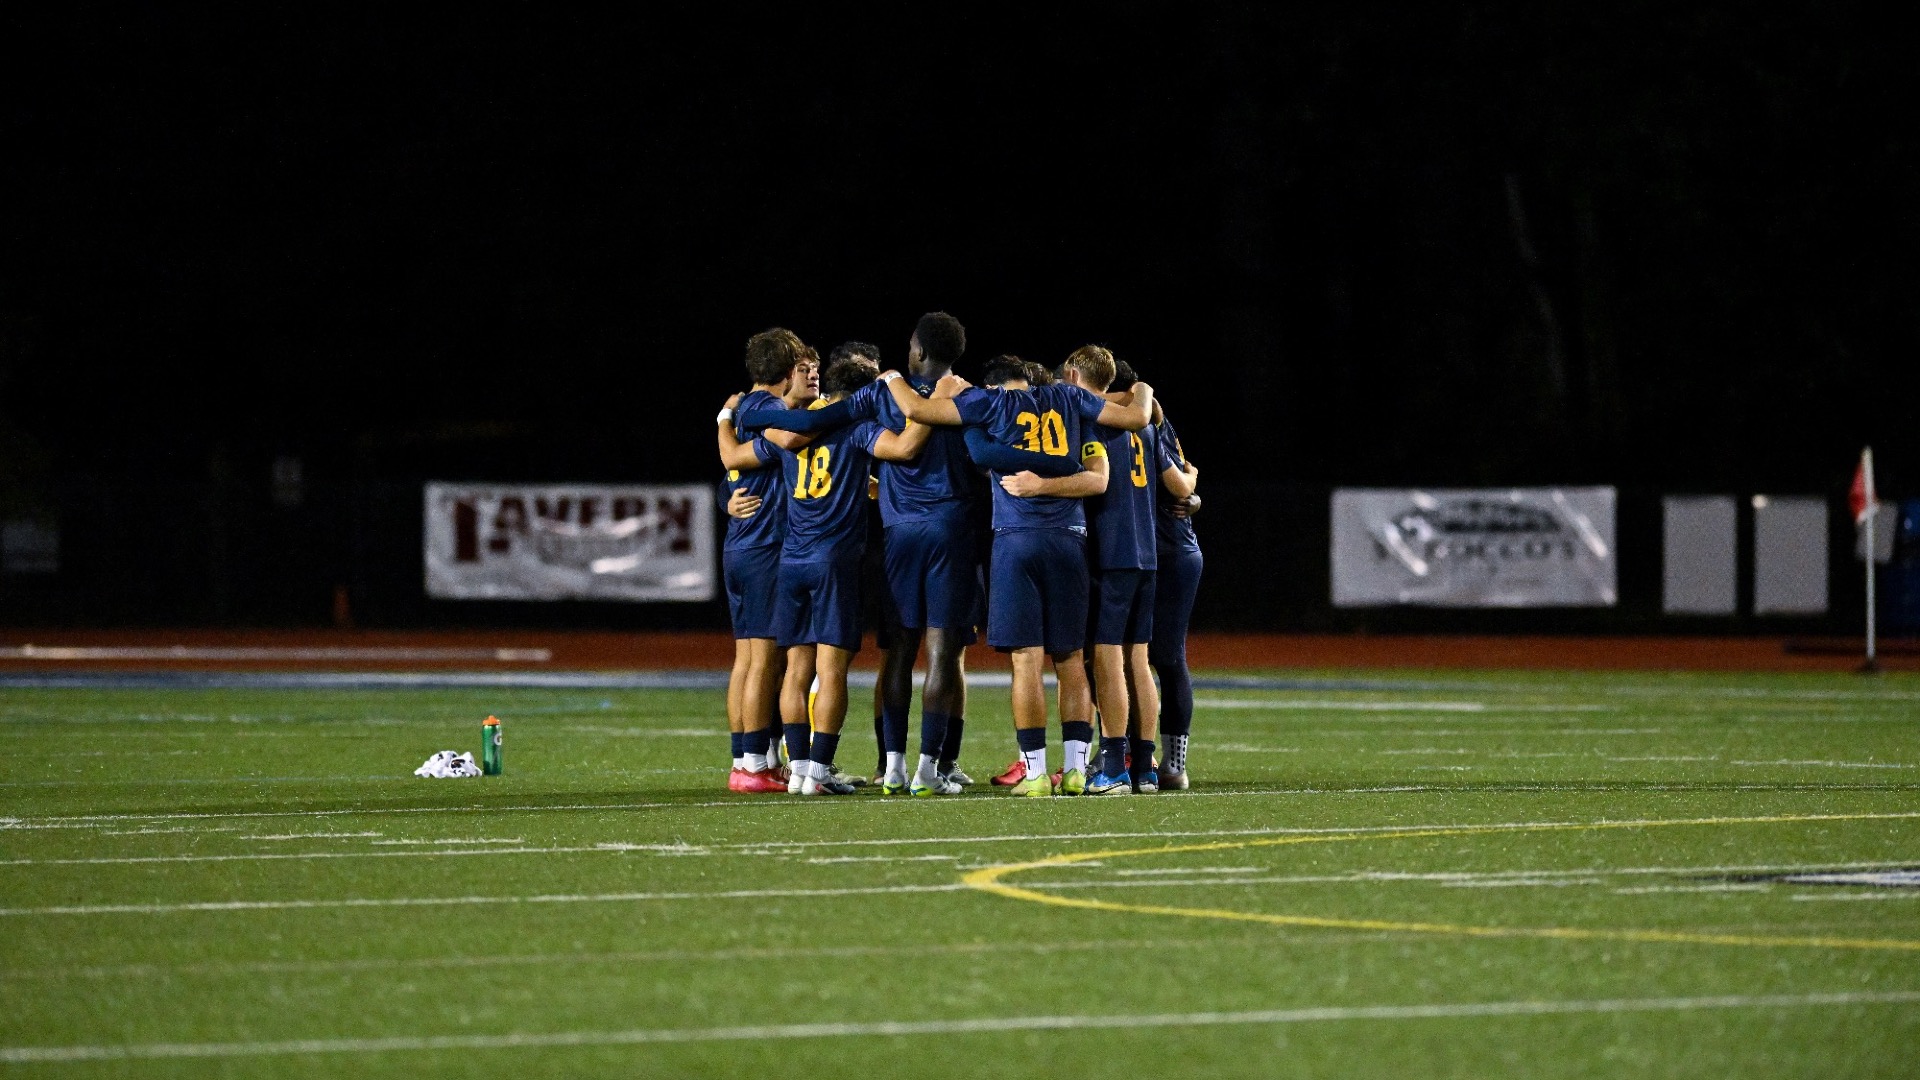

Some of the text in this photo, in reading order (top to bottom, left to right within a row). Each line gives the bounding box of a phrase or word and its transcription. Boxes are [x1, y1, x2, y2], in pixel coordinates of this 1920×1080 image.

[1014, 408, 1070, 457] 30
[1084, 443, 1096, 457] C
[793, 445, 833, 499] 18
[1130, 432, 1148, 488] 3
